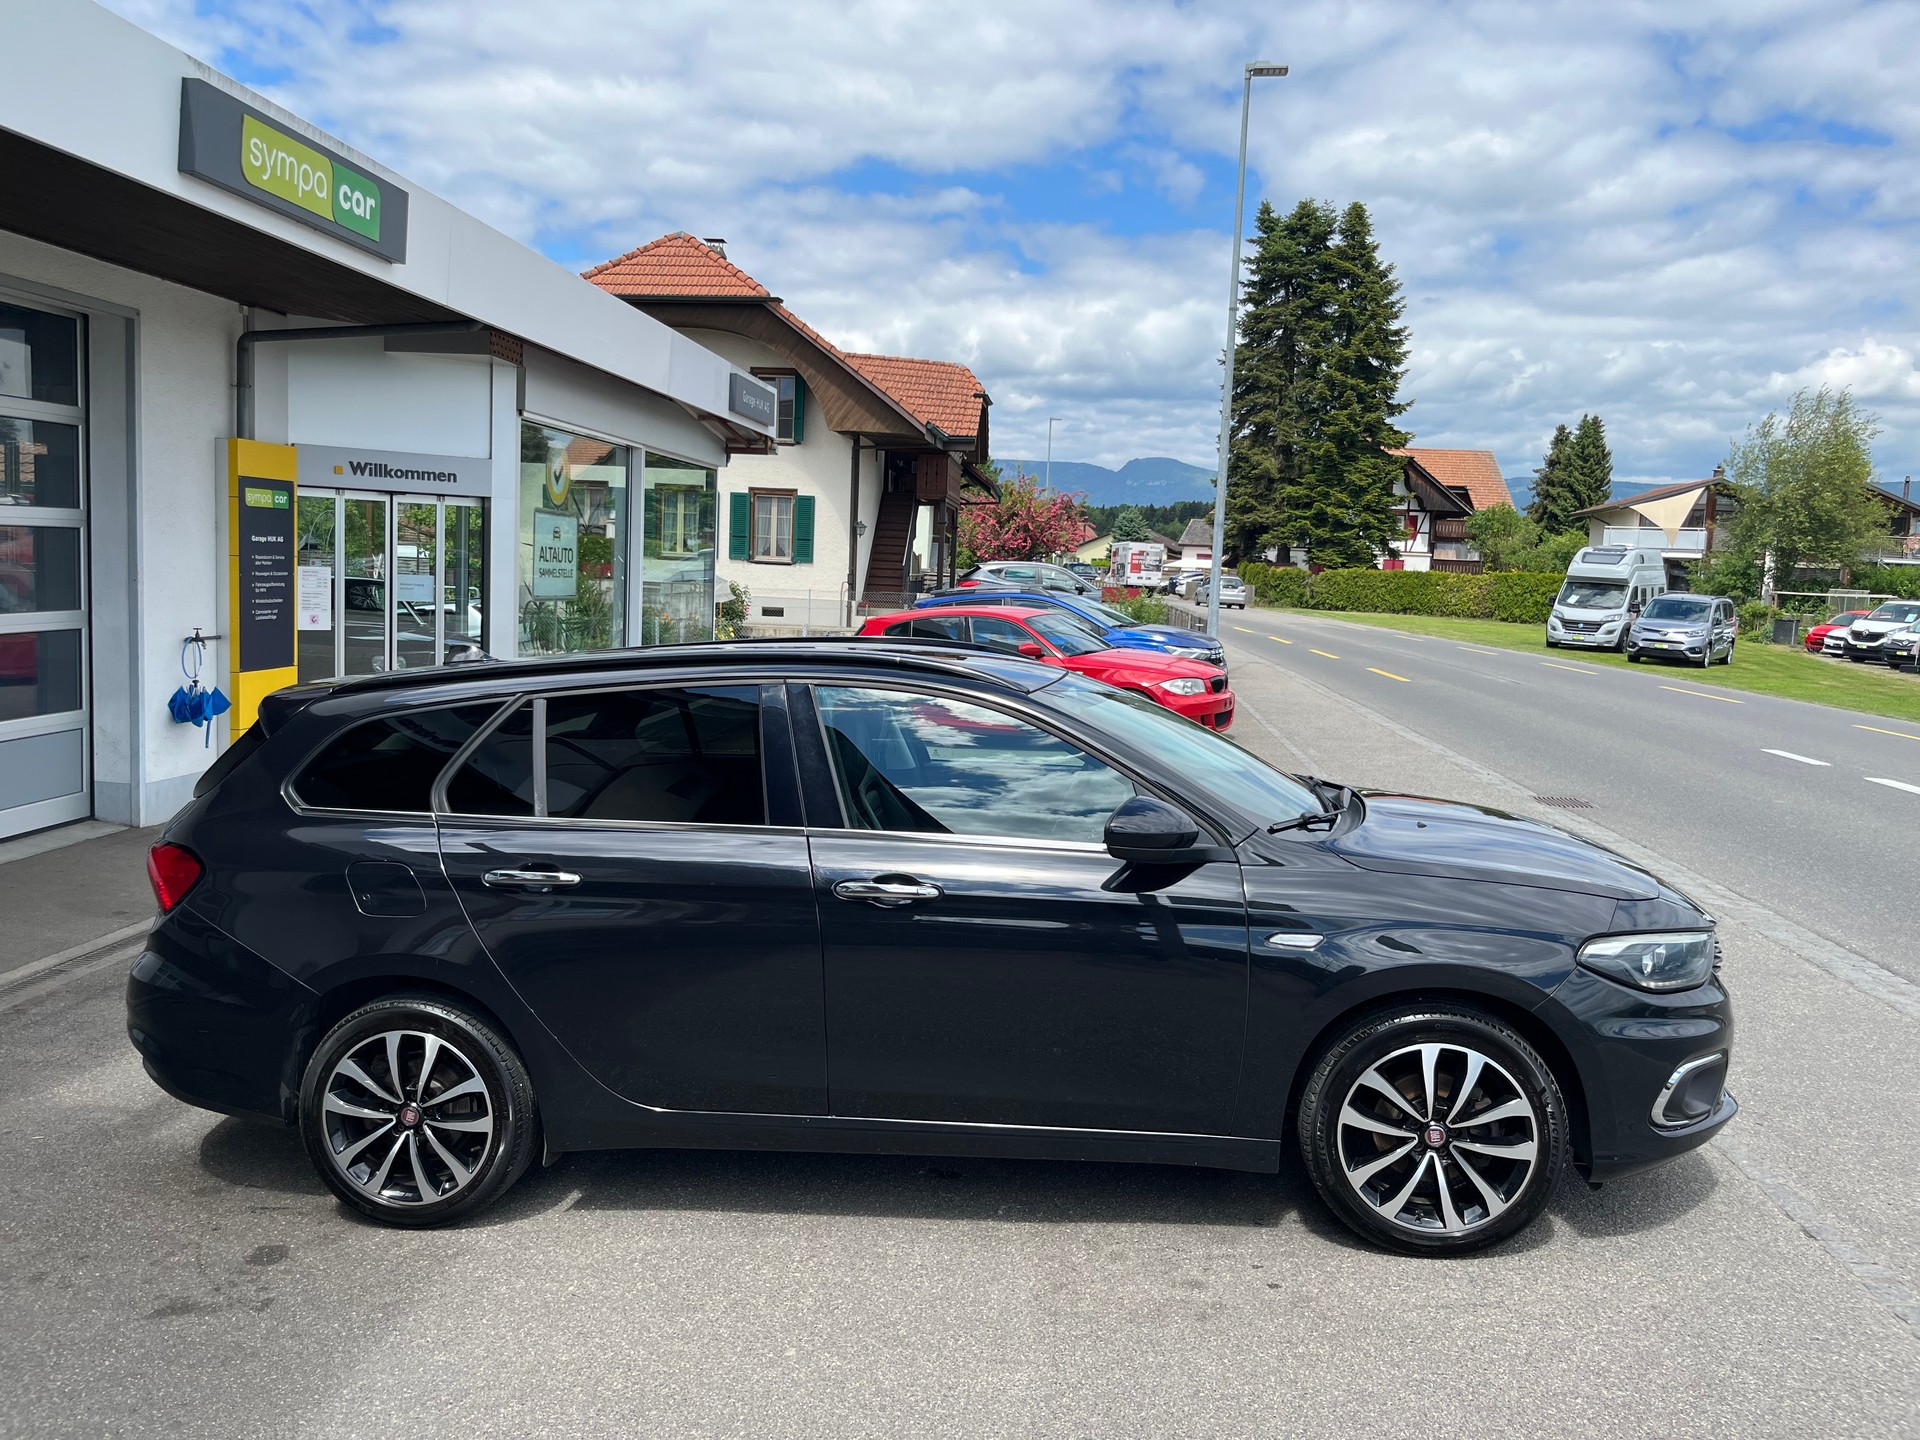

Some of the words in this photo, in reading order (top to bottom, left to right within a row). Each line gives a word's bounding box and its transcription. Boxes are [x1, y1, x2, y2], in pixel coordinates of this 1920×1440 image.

[250, 138, 327, 199] sympa
[338, 184, 376, 220] car
[742, 390, 756, 408] Garage
[764, 402, 770, 413] AG
[348, 461, 458, 483] Willkommen
[247, 492, 272, 506] sympa
[274, 494, 288, 504] car
[539, 546, 573, 563] ALTAUTO
[539, 568, 573, 578] SAMMELSTELLE
[1430, 1130, 1441, 1142] FIAT
[1547, 1110, 1559, 1176] MICHELIN
